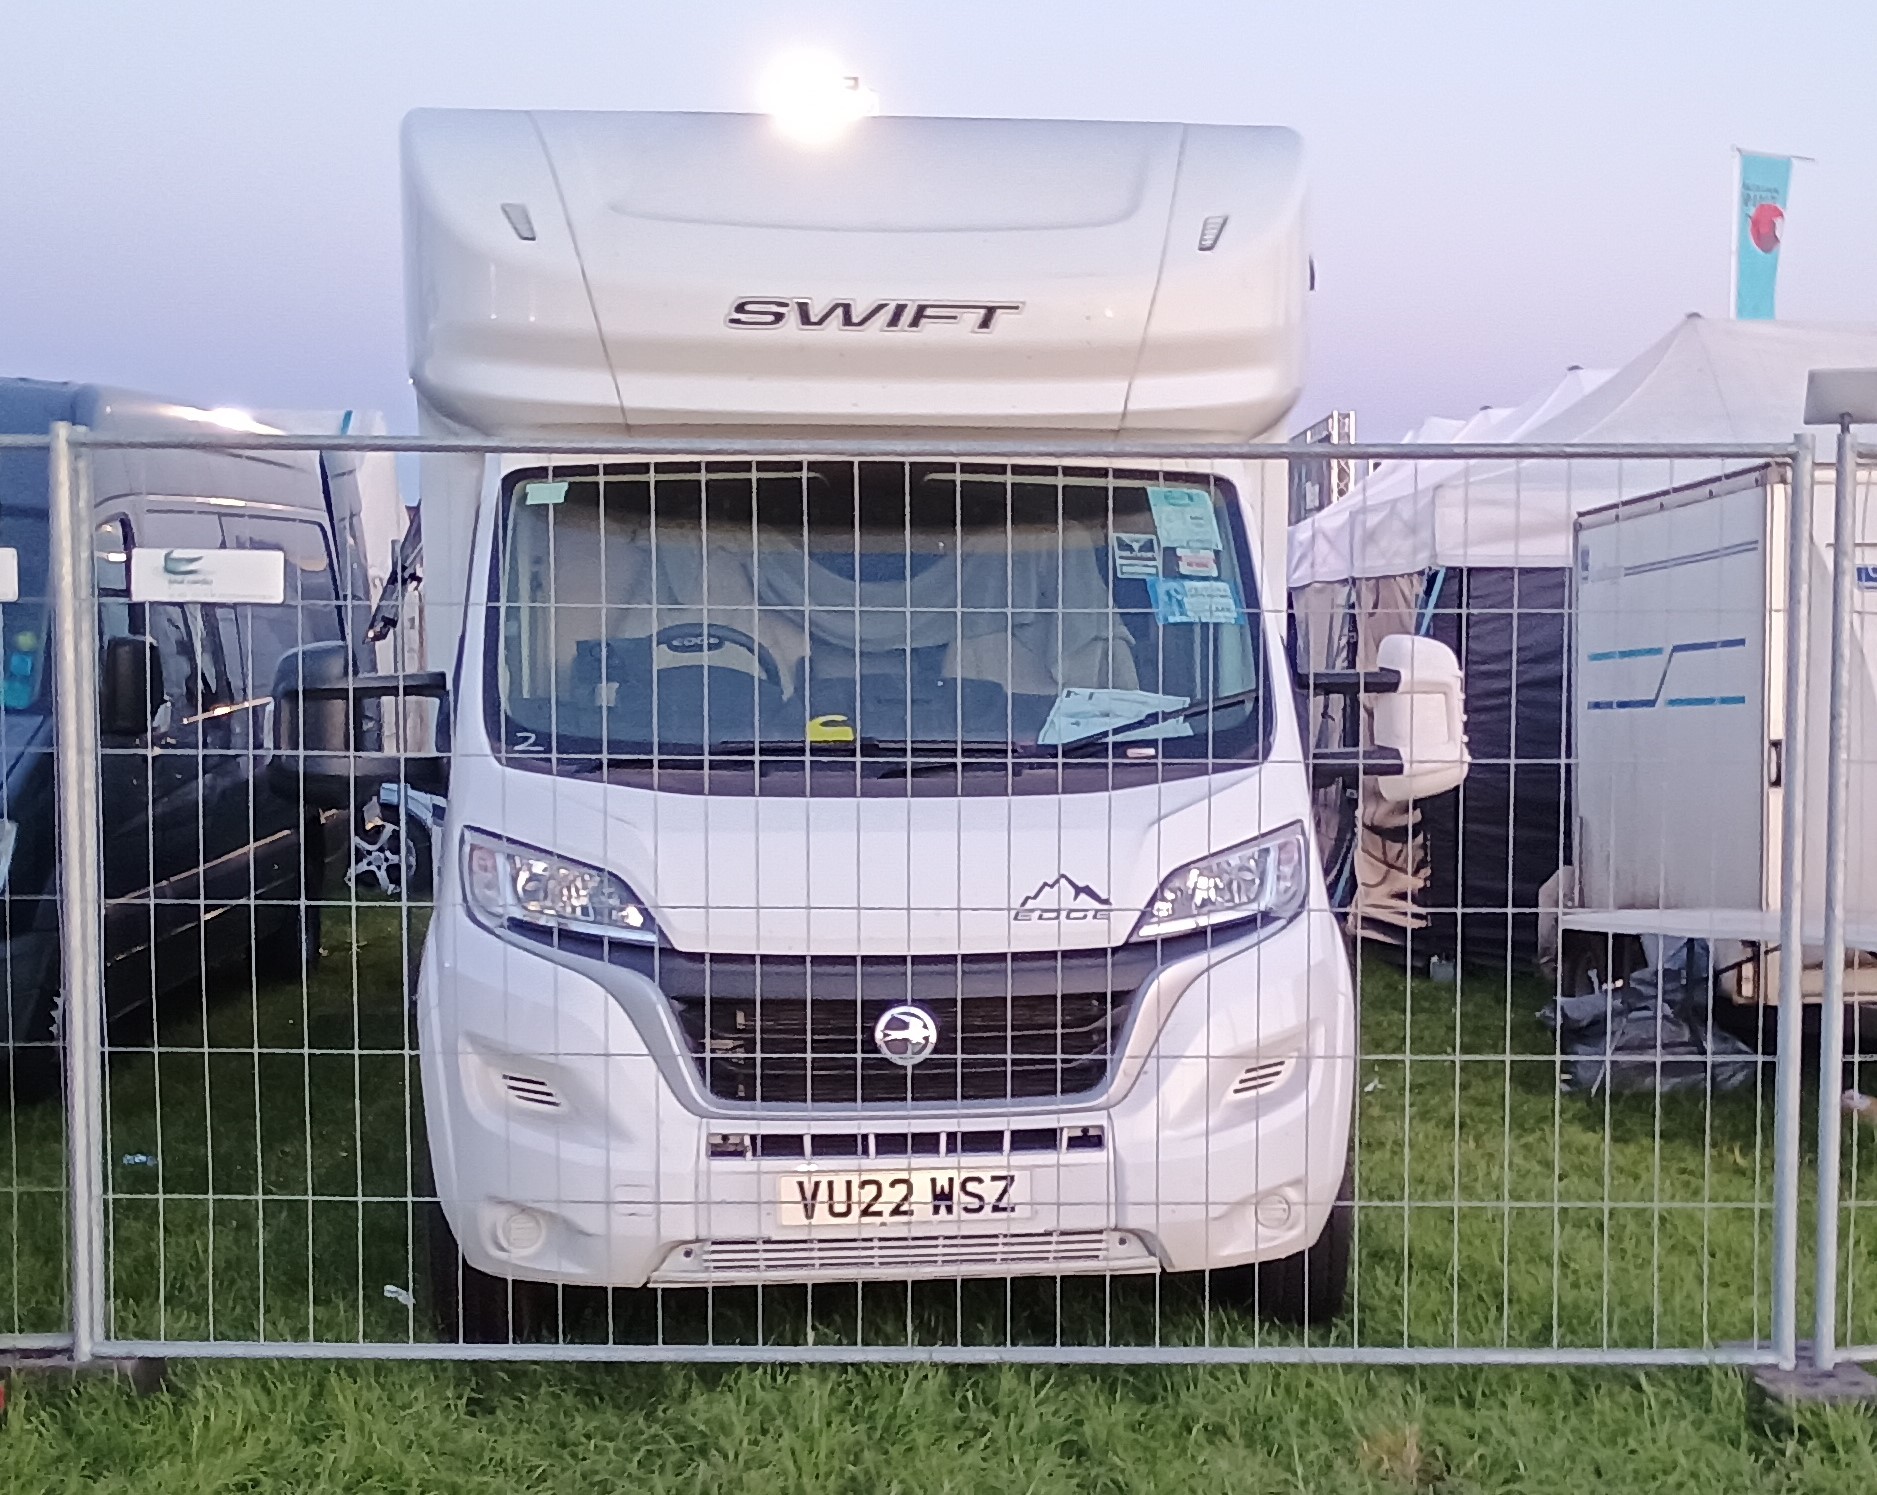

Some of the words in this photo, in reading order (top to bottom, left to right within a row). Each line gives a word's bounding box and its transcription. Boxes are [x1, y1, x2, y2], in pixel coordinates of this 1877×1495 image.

[726, 299, 1022, 331] SWIFT
[1013, 908, 1110, 921] EDGE
[796, 1177, 914, 1221] VU22
[930, 1174, 1016, 1216] WSZ
